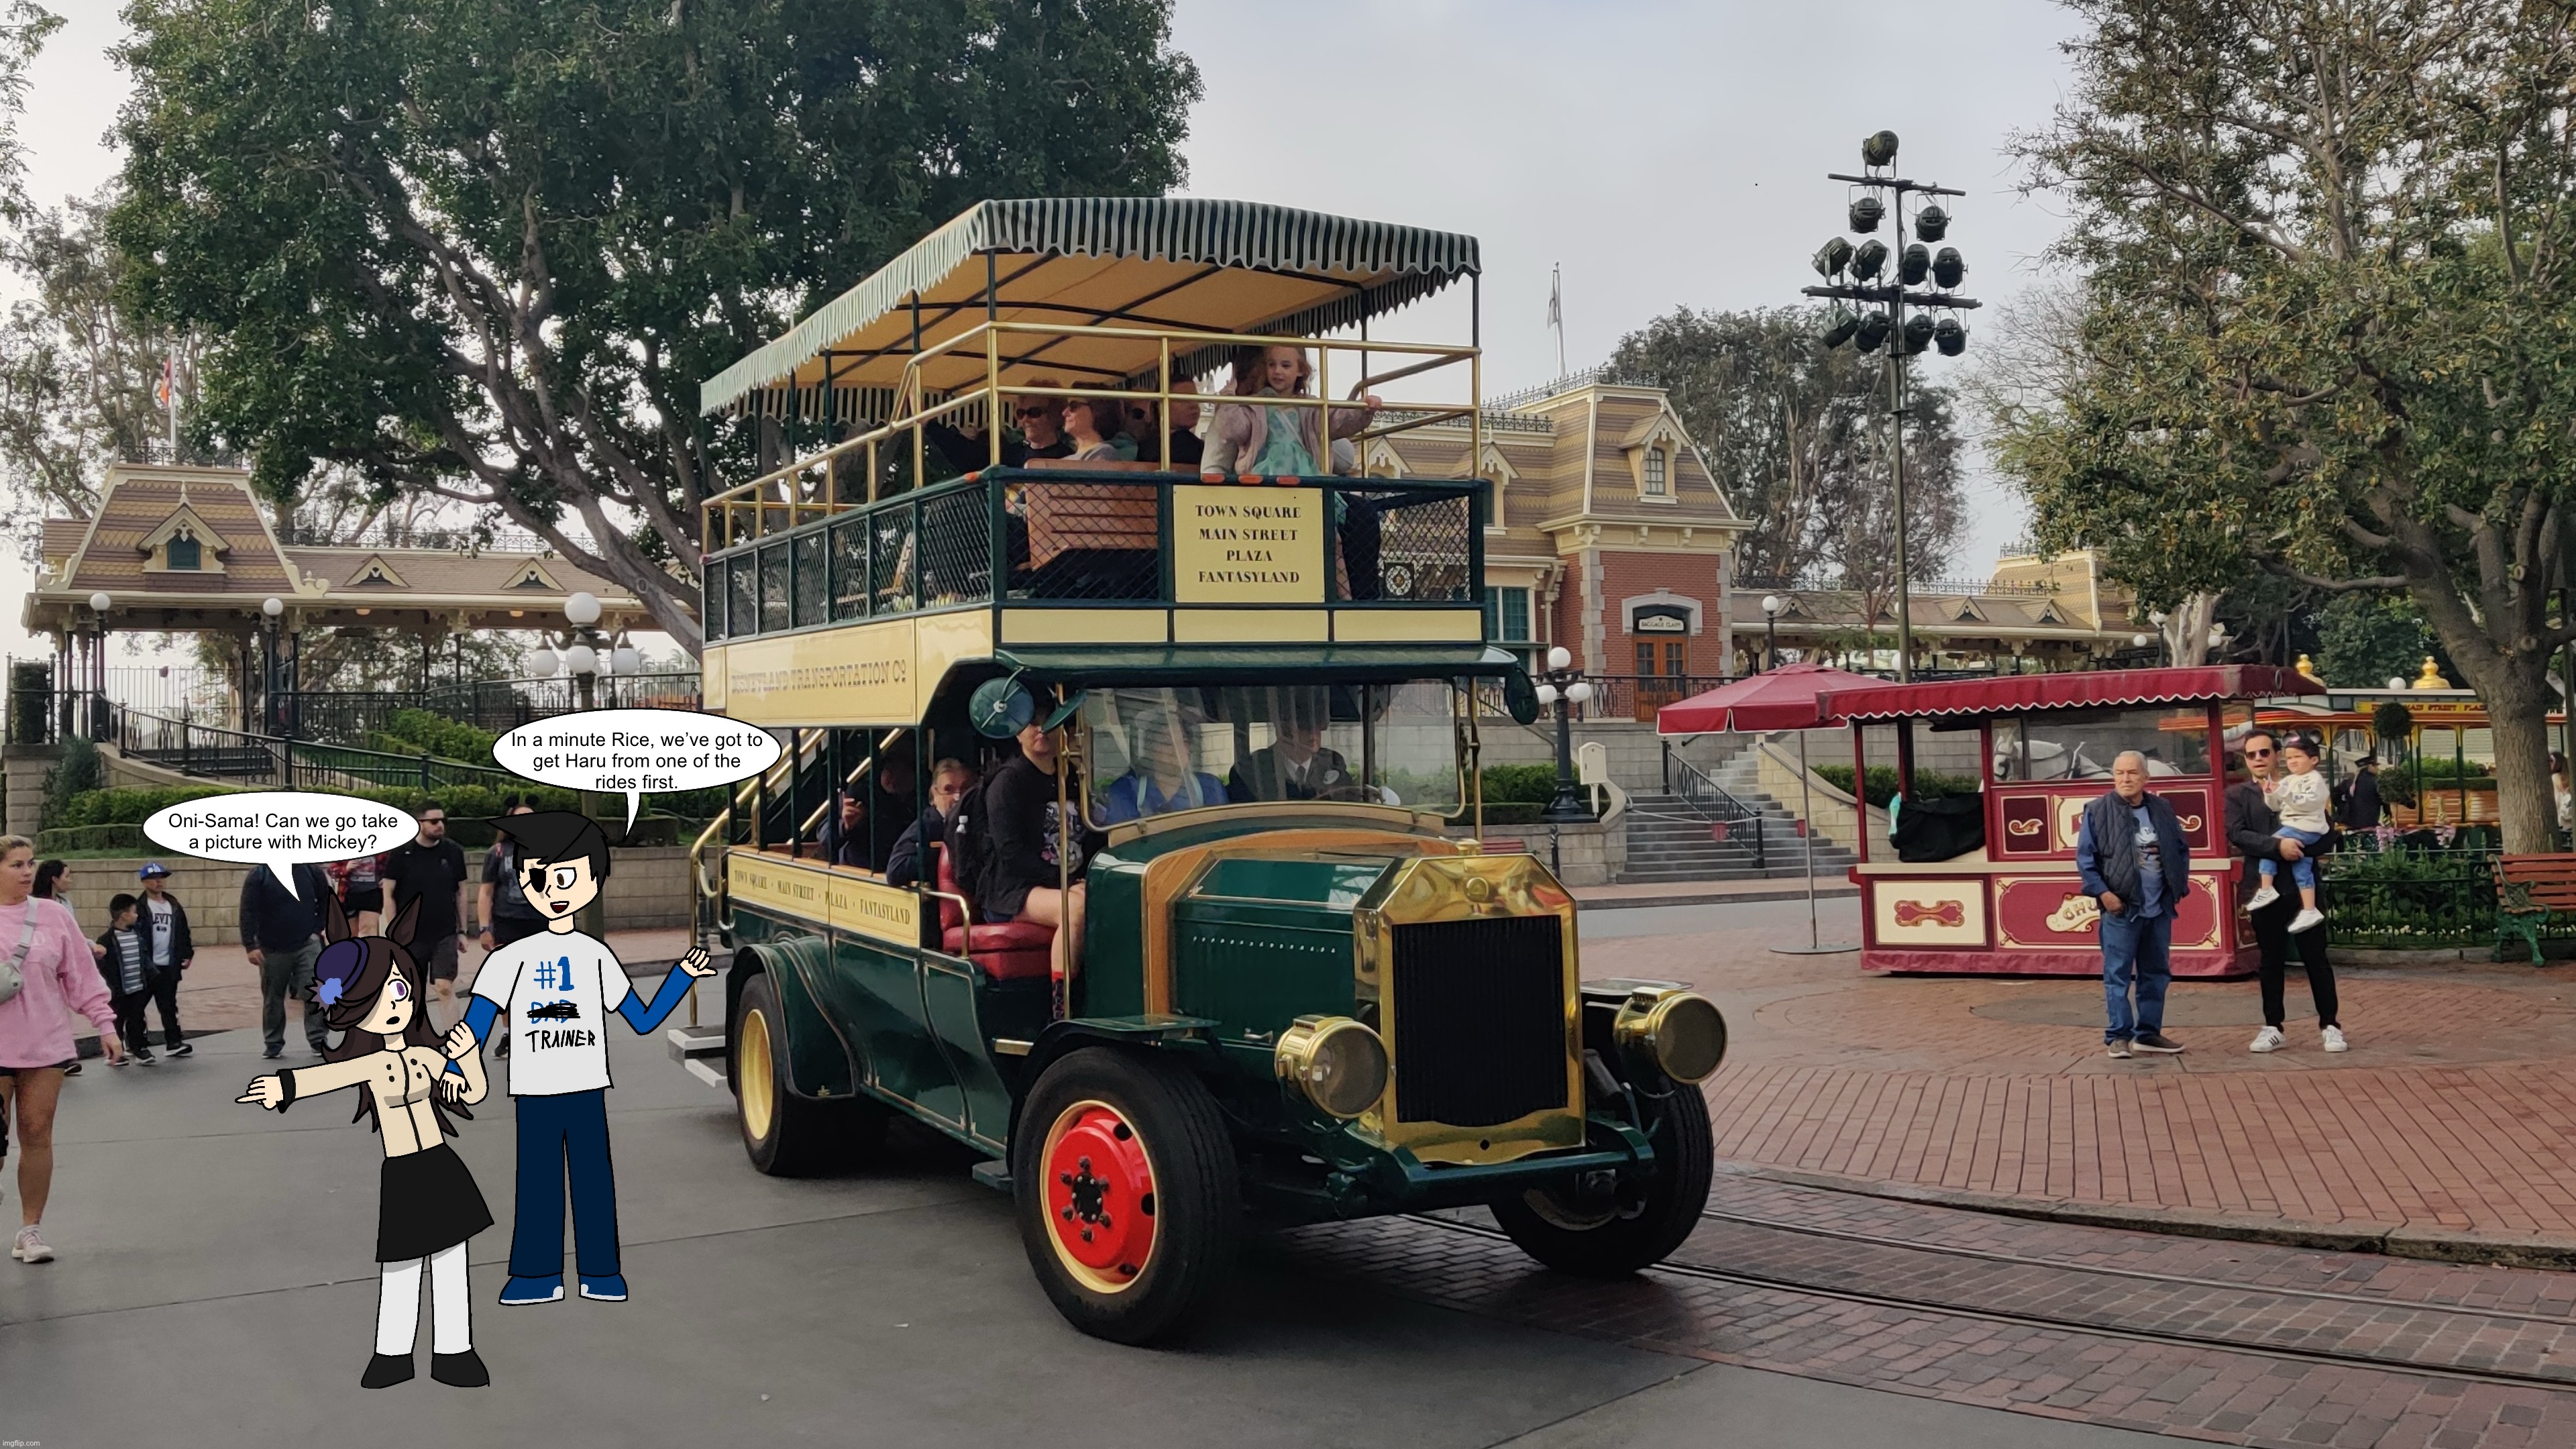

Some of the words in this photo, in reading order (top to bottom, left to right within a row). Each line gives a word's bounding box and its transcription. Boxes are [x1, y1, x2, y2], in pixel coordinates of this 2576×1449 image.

[1195, 504, 1238, 517] TOWN
[1242, 506, 1301, 520] SQUARE
[1199, 528, 1237, 540] MAIN
[1242, 529, 1298, 540] STREET
[1226, 550, 1273, 561] PLAZA
[1198, 571, 1300, 582] FANTASYLAND
[790, 661, 890, 690] TRANSPORTATION
[734, 869, 748, 884] TOWN
[777, 879, 791, 895] MAIN
[793, 883, 814, 901] STREET
[825, 891, 847, 910] PLAZA
[860, 898, 910, 924] FANTASYLAND
